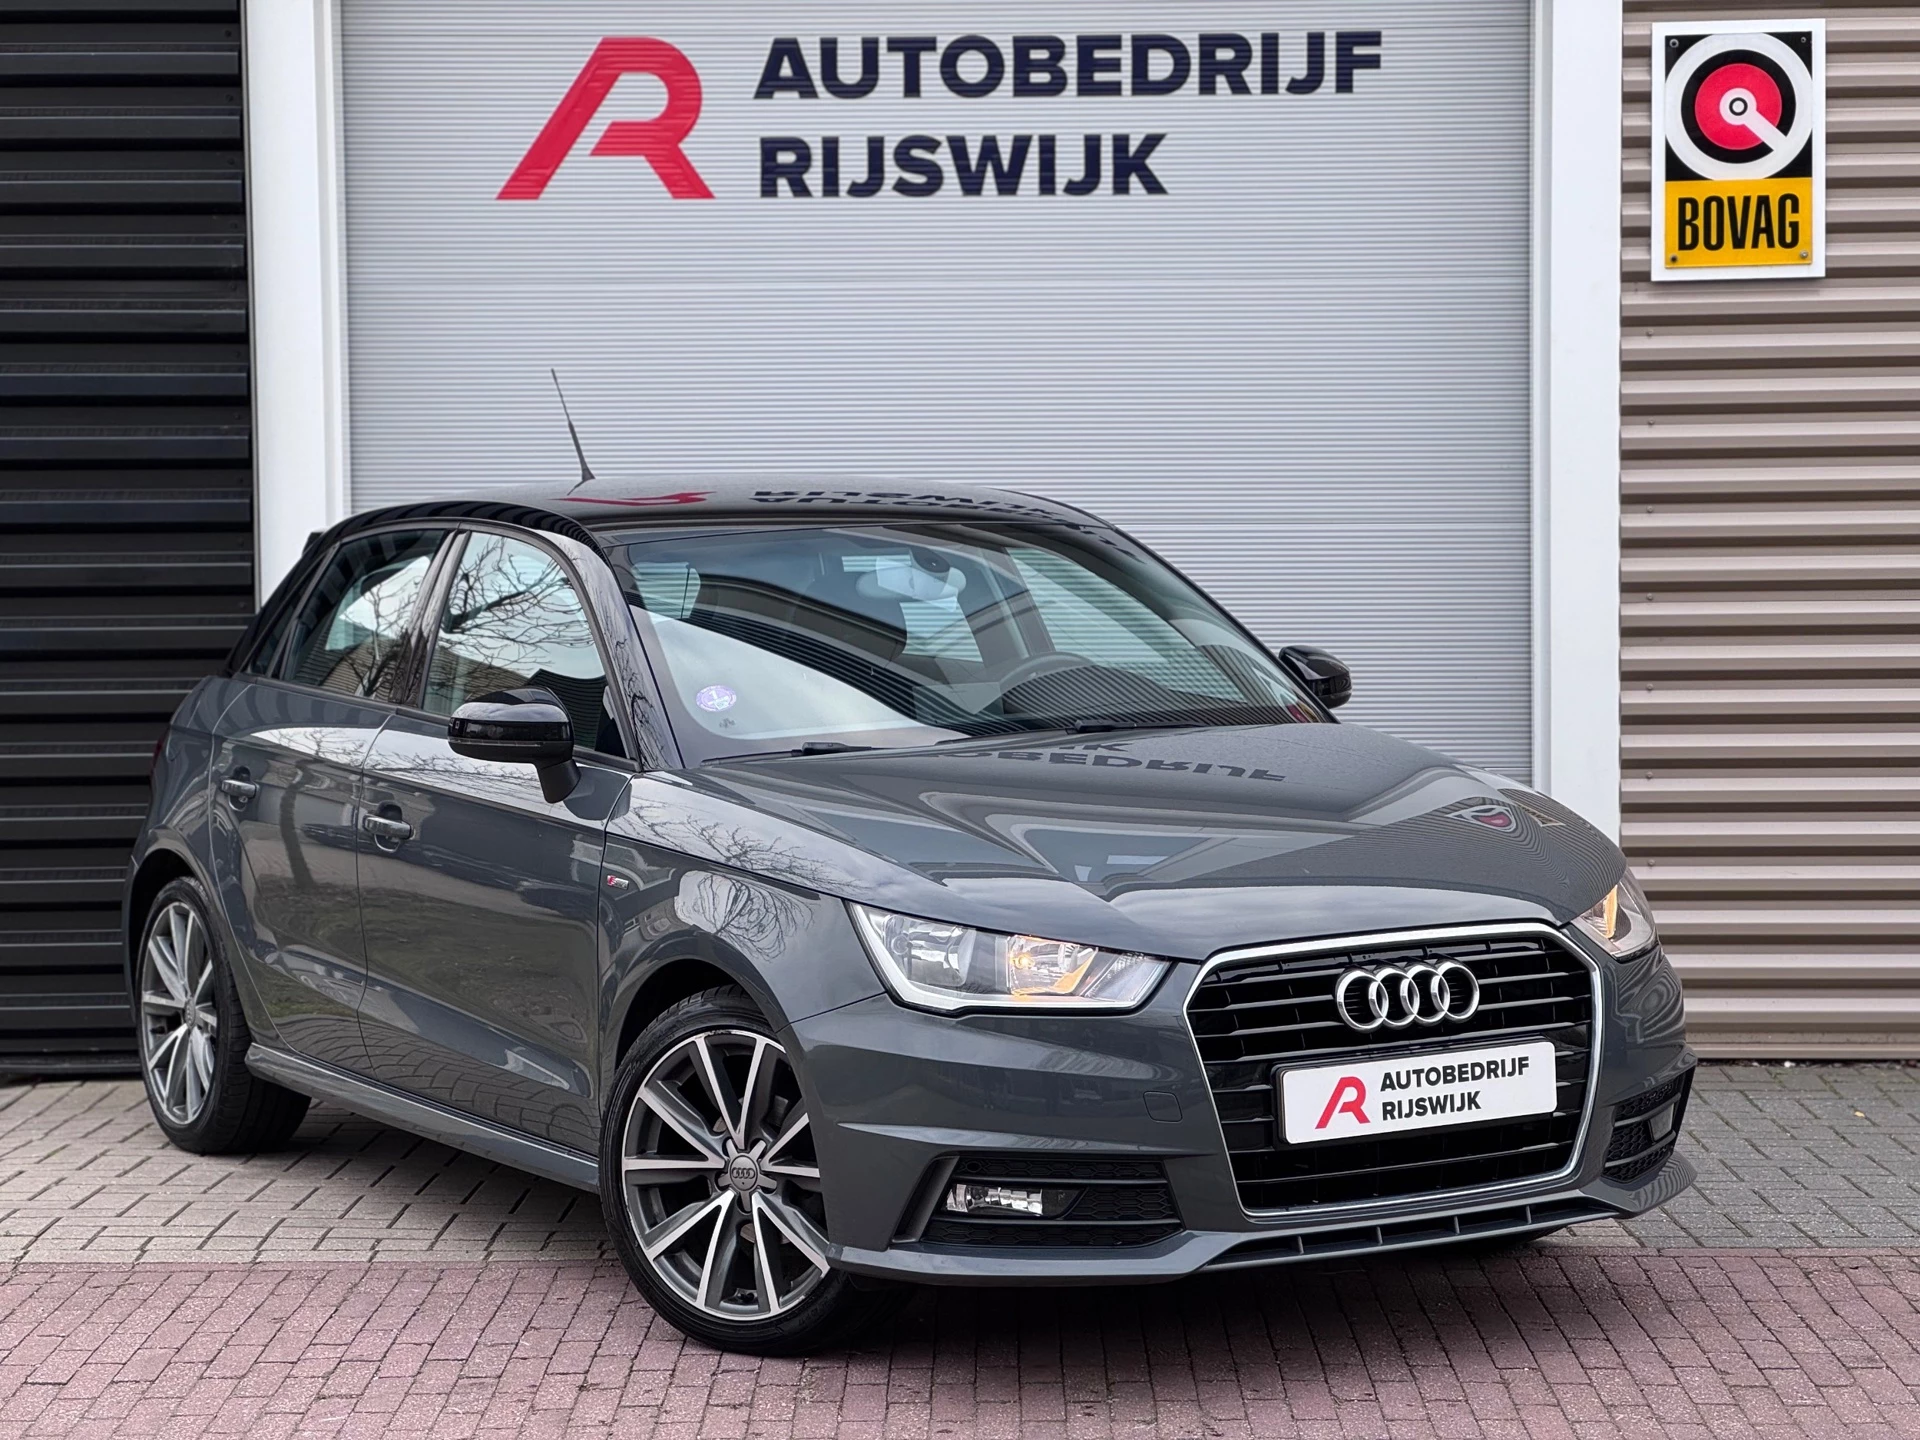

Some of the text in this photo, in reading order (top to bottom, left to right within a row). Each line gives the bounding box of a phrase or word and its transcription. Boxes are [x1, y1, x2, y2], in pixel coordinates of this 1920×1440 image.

[754, 31, 1382, 100] AUTOBEDRIJF
[760, 133, 1168, 198] RIJSWIJK
[1677, 193, 1800, 251] BOVAG
[1380, 1056, 1529, 1092] AUTOBEDRIJF
[1382, 1090, 1481, 1121] RIJSWIJK
